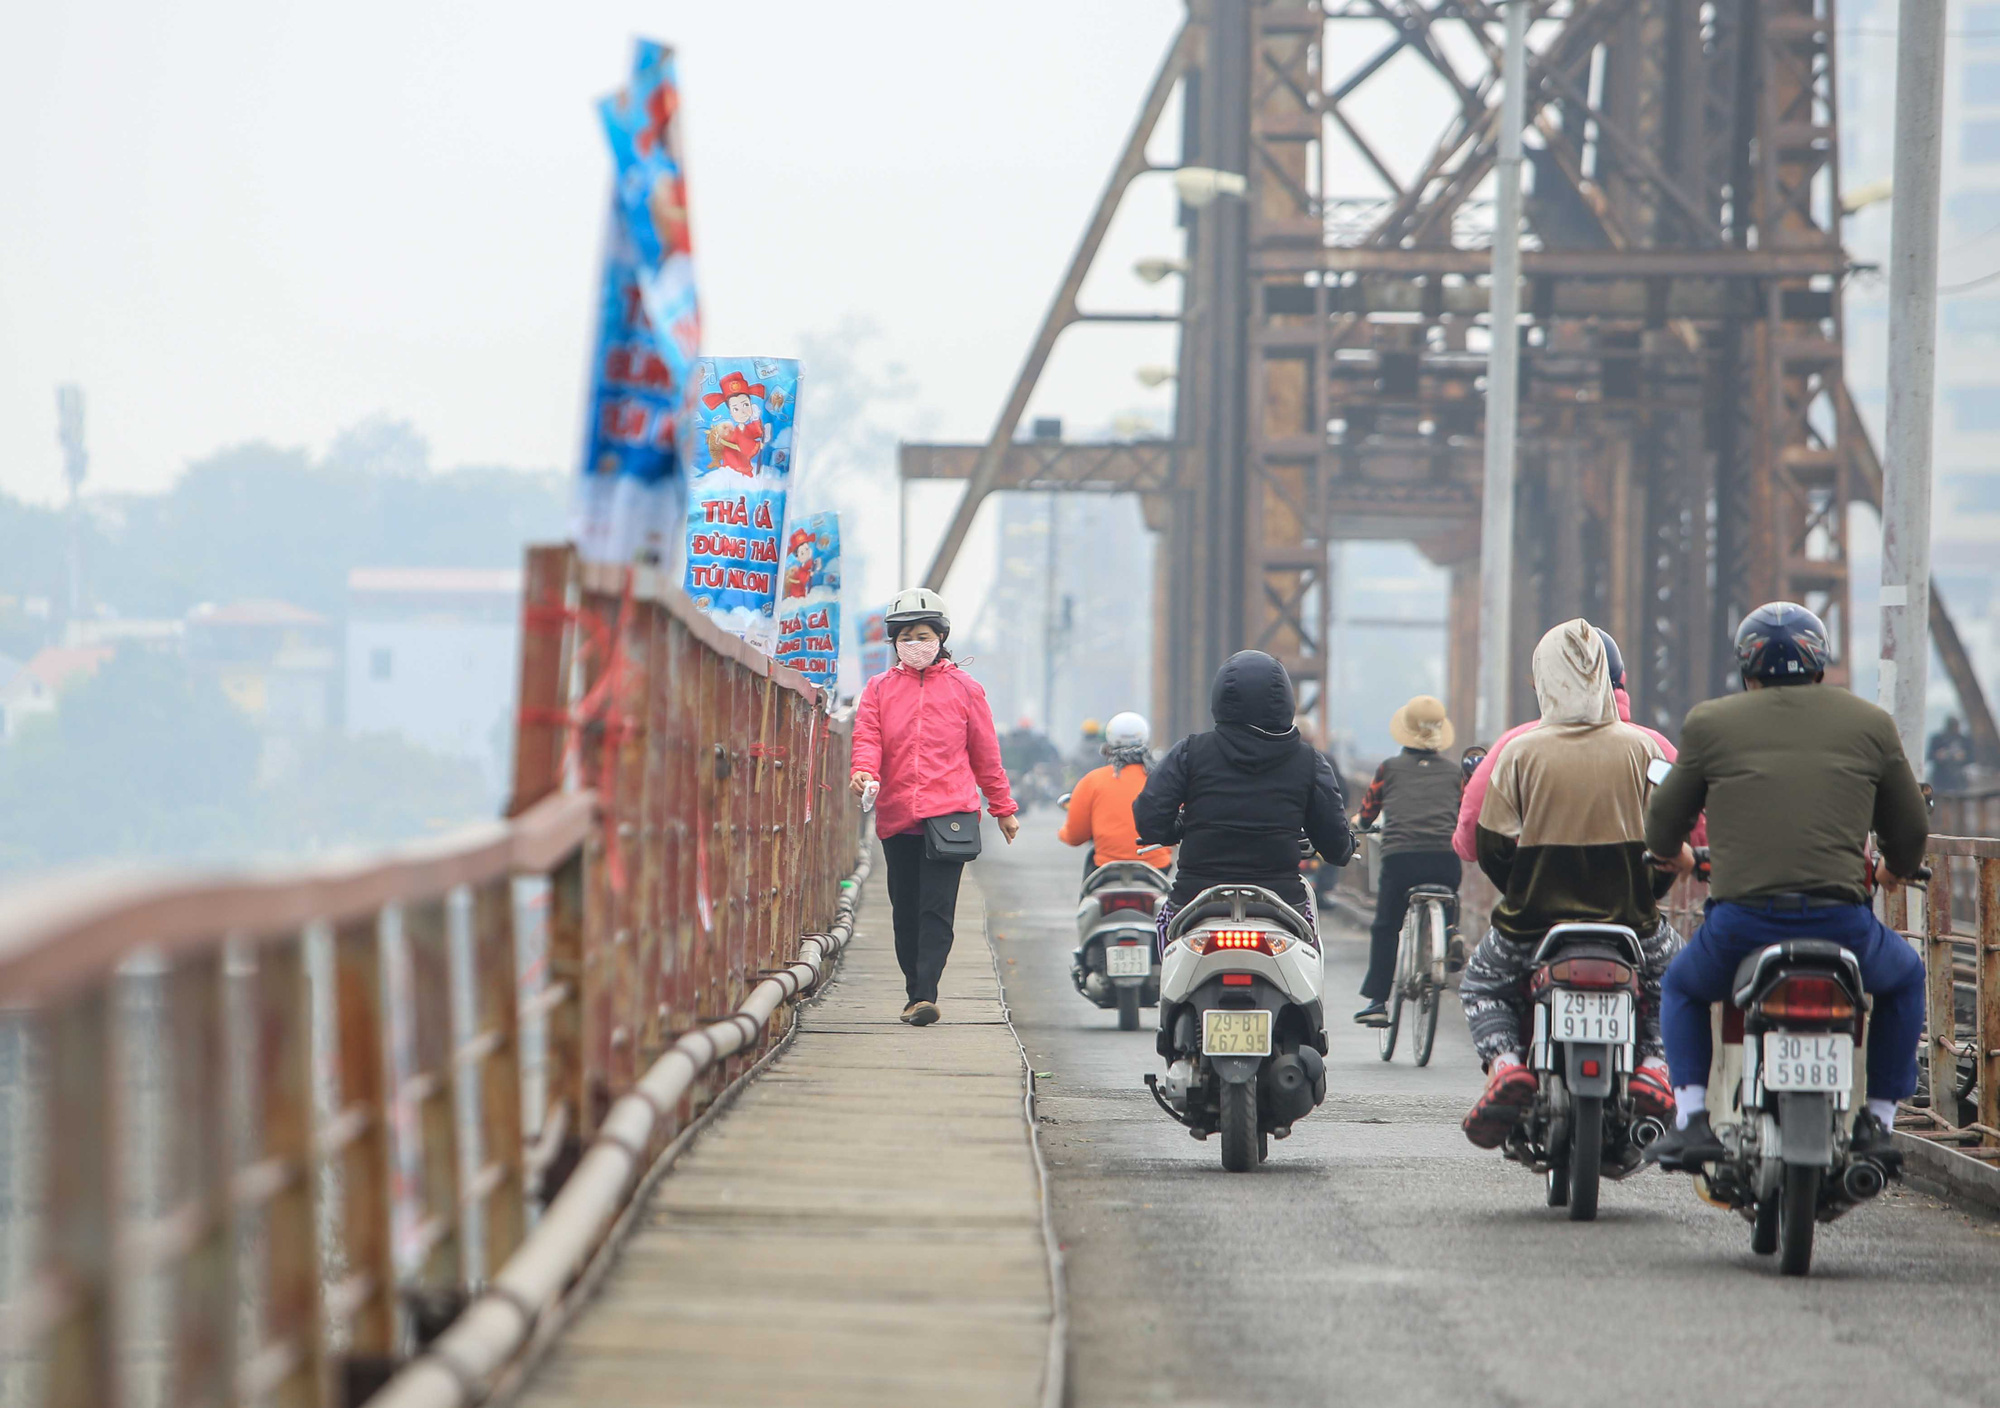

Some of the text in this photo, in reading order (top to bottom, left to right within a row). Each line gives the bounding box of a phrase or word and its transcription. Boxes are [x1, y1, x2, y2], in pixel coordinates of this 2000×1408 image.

[702, 496, 748, 526] THẢ
[751, 537, 777, 562] THẢ
[692, 564, 724, 587] TÚI
[807, 608, 829, 629] CÁ
[805, 633, 833, 651] THẢ
[1564, 993, 1619, 1016] 29-H7
[1213, 1014, 1260, 1032] 29-B1
[1564, 1016, 1619, 1039] 9119
[1208, 1034, 1266, 1052] 467.95
[1778, 1037, 1838, 1060] 30-L4
[1778, 1063, 1838, 1086] 5988
